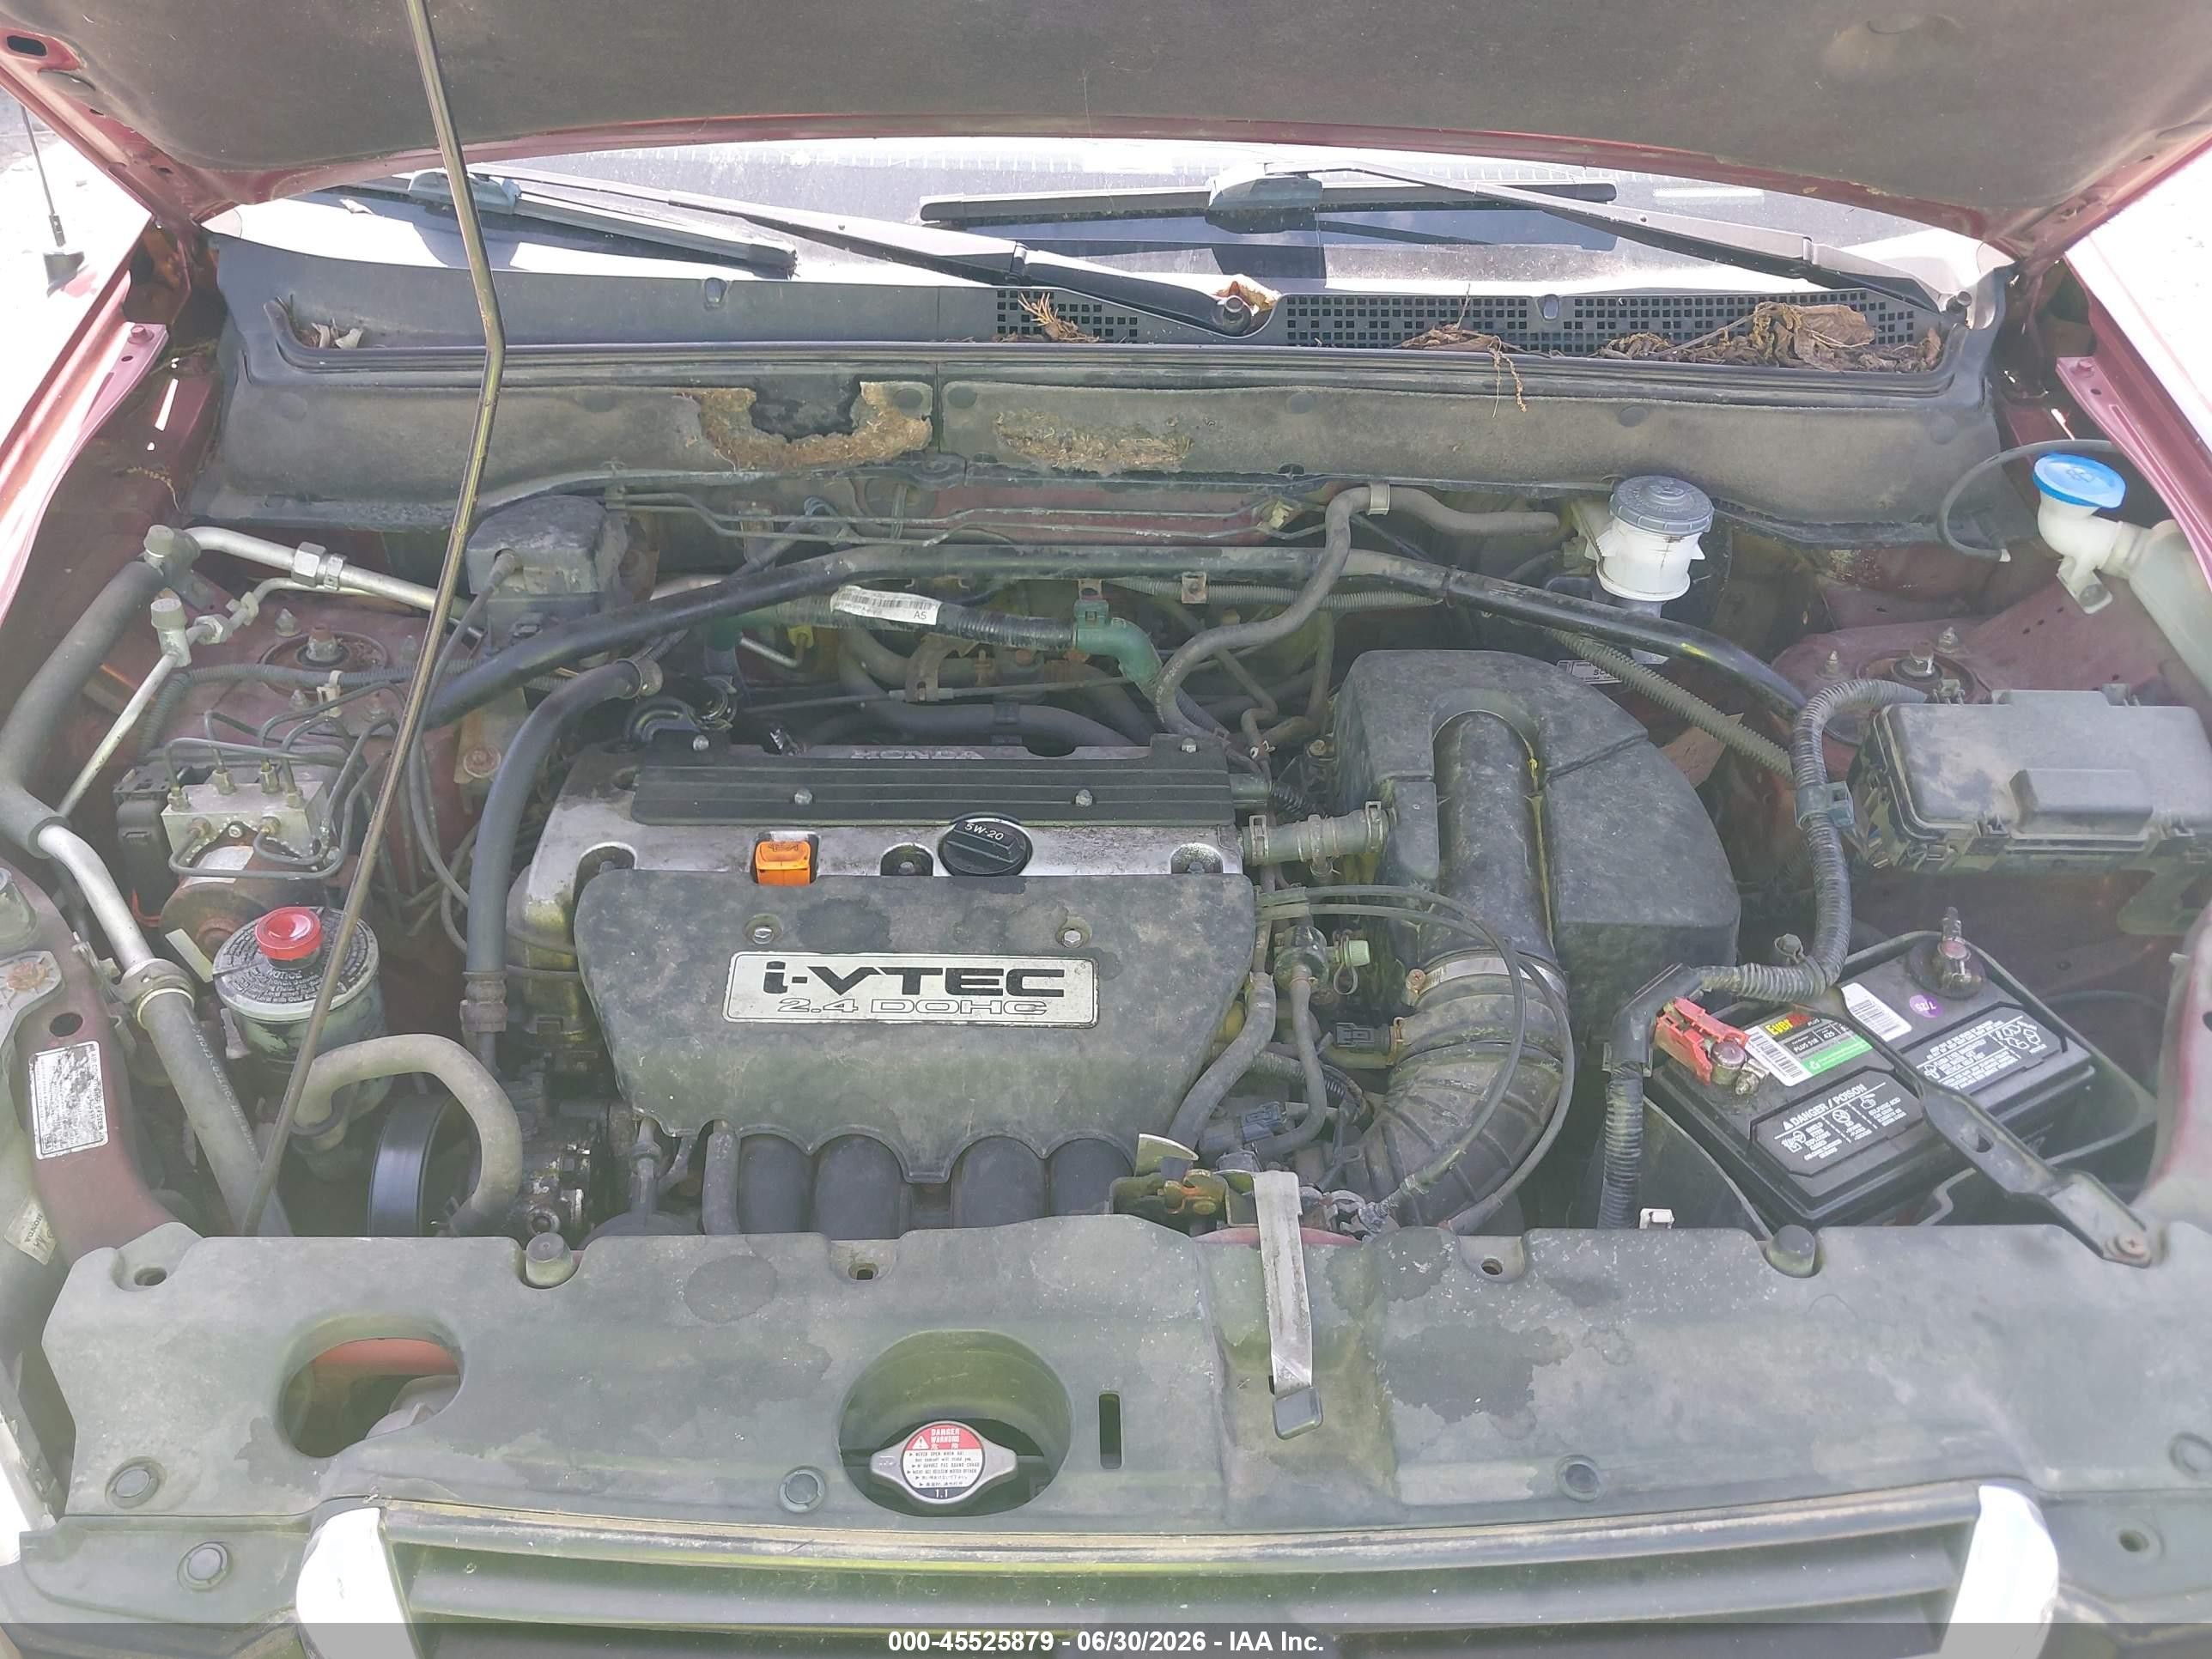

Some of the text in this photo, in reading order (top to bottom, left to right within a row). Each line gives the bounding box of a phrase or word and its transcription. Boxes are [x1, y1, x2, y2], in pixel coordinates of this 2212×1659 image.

[850, 749, 985, 760] HONDA
[964, 822, 1004, 842] 5W-20
[267, 968, 302, 980] NOTICE
[763, 961, 1065, 998] i-VTEC
[777, 998, 1048, 1017] 2.4 DOHC
[1790, 1103, 1829, 1127] DANGER
[1832, 1083, 1868, 1105] POISON
[935, 1489, 949, 1498] 1.1
